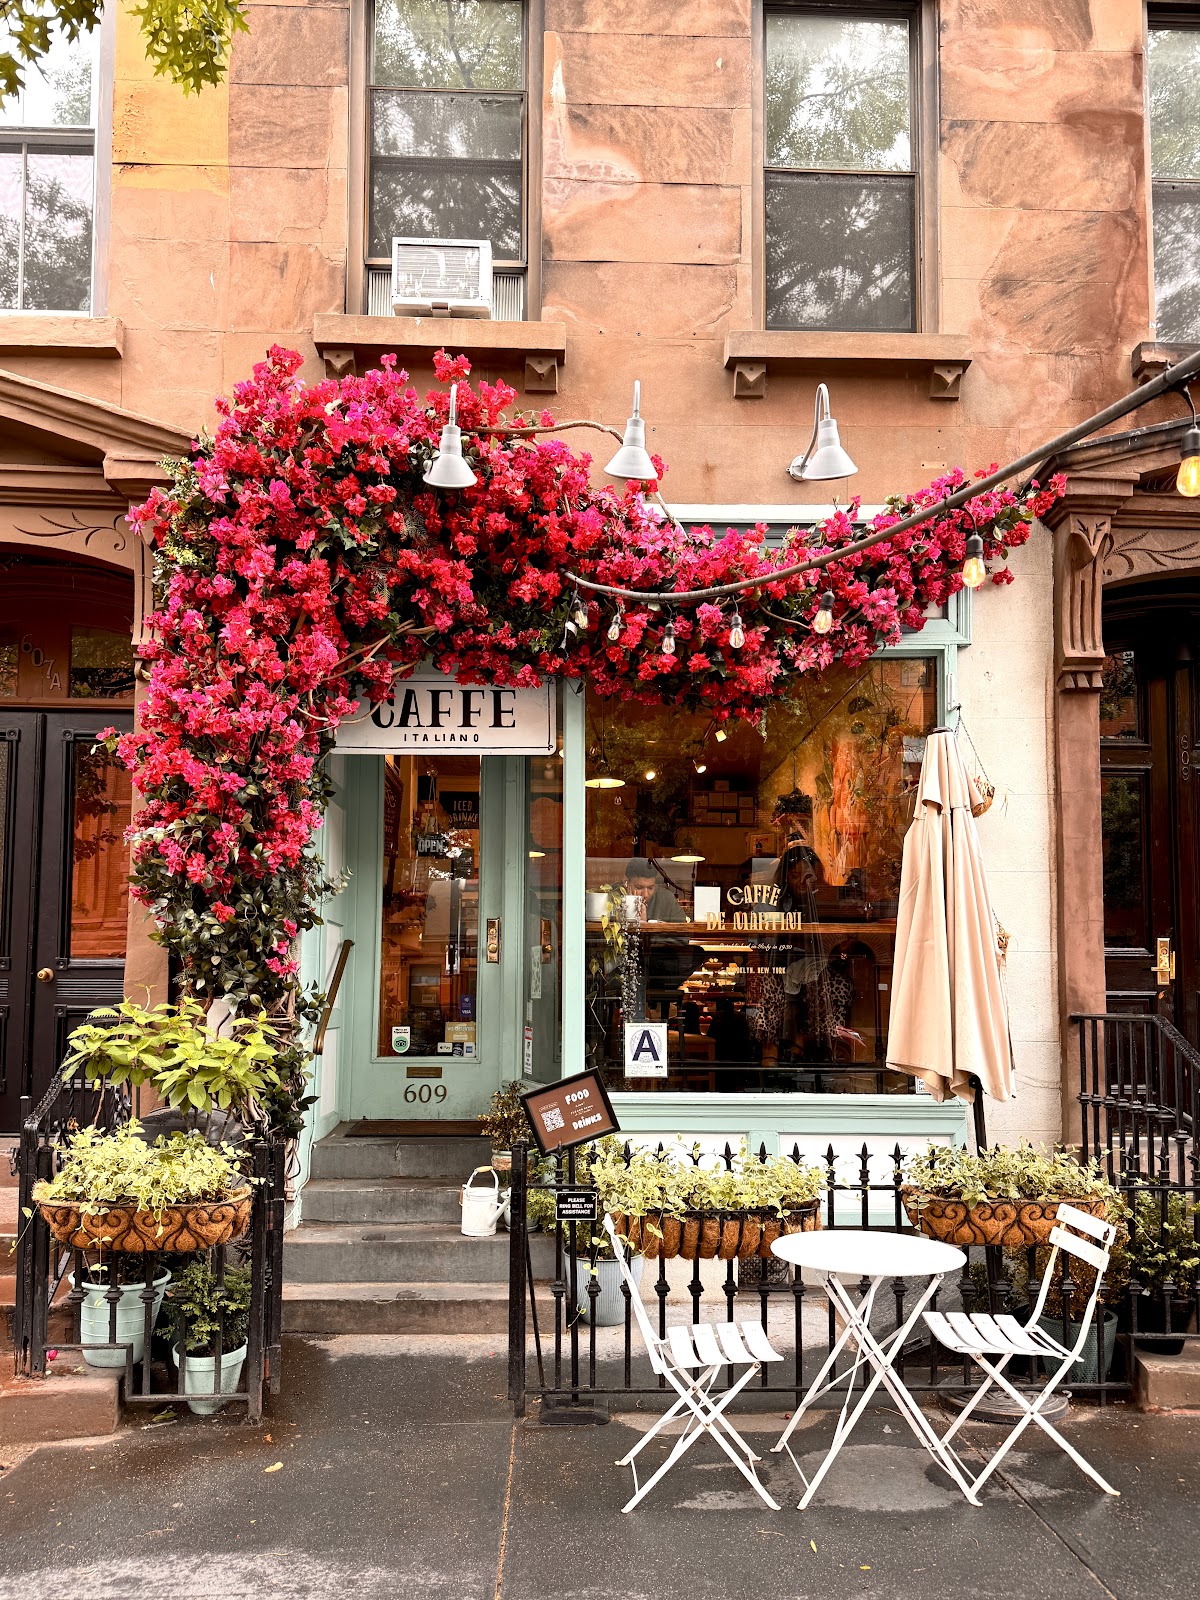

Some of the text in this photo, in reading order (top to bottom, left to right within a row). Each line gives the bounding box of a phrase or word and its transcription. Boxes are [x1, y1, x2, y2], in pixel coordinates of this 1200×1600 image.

[21, 633, 63, 691] 607A
[370, 685, 516, 729] CAFFÈ
[403, 733, 480, 743] ITALIANO
[1180, 734, 1191, 781] 609
[453, 800, 473, 812] ICED
[418, 839, 444, 853] OPEN
[726, 883, 781, 907] CAFFÈ
[706, 911, 802, 931] DE MARTINI
[757, 966, 770, 974] NEW
[772, 966, 786, 974] YORK
[632, 1030, 660, 1061] A
[404, 1083, 447, 1104] 609
[565, 1089, 590, 1105] FOOD
